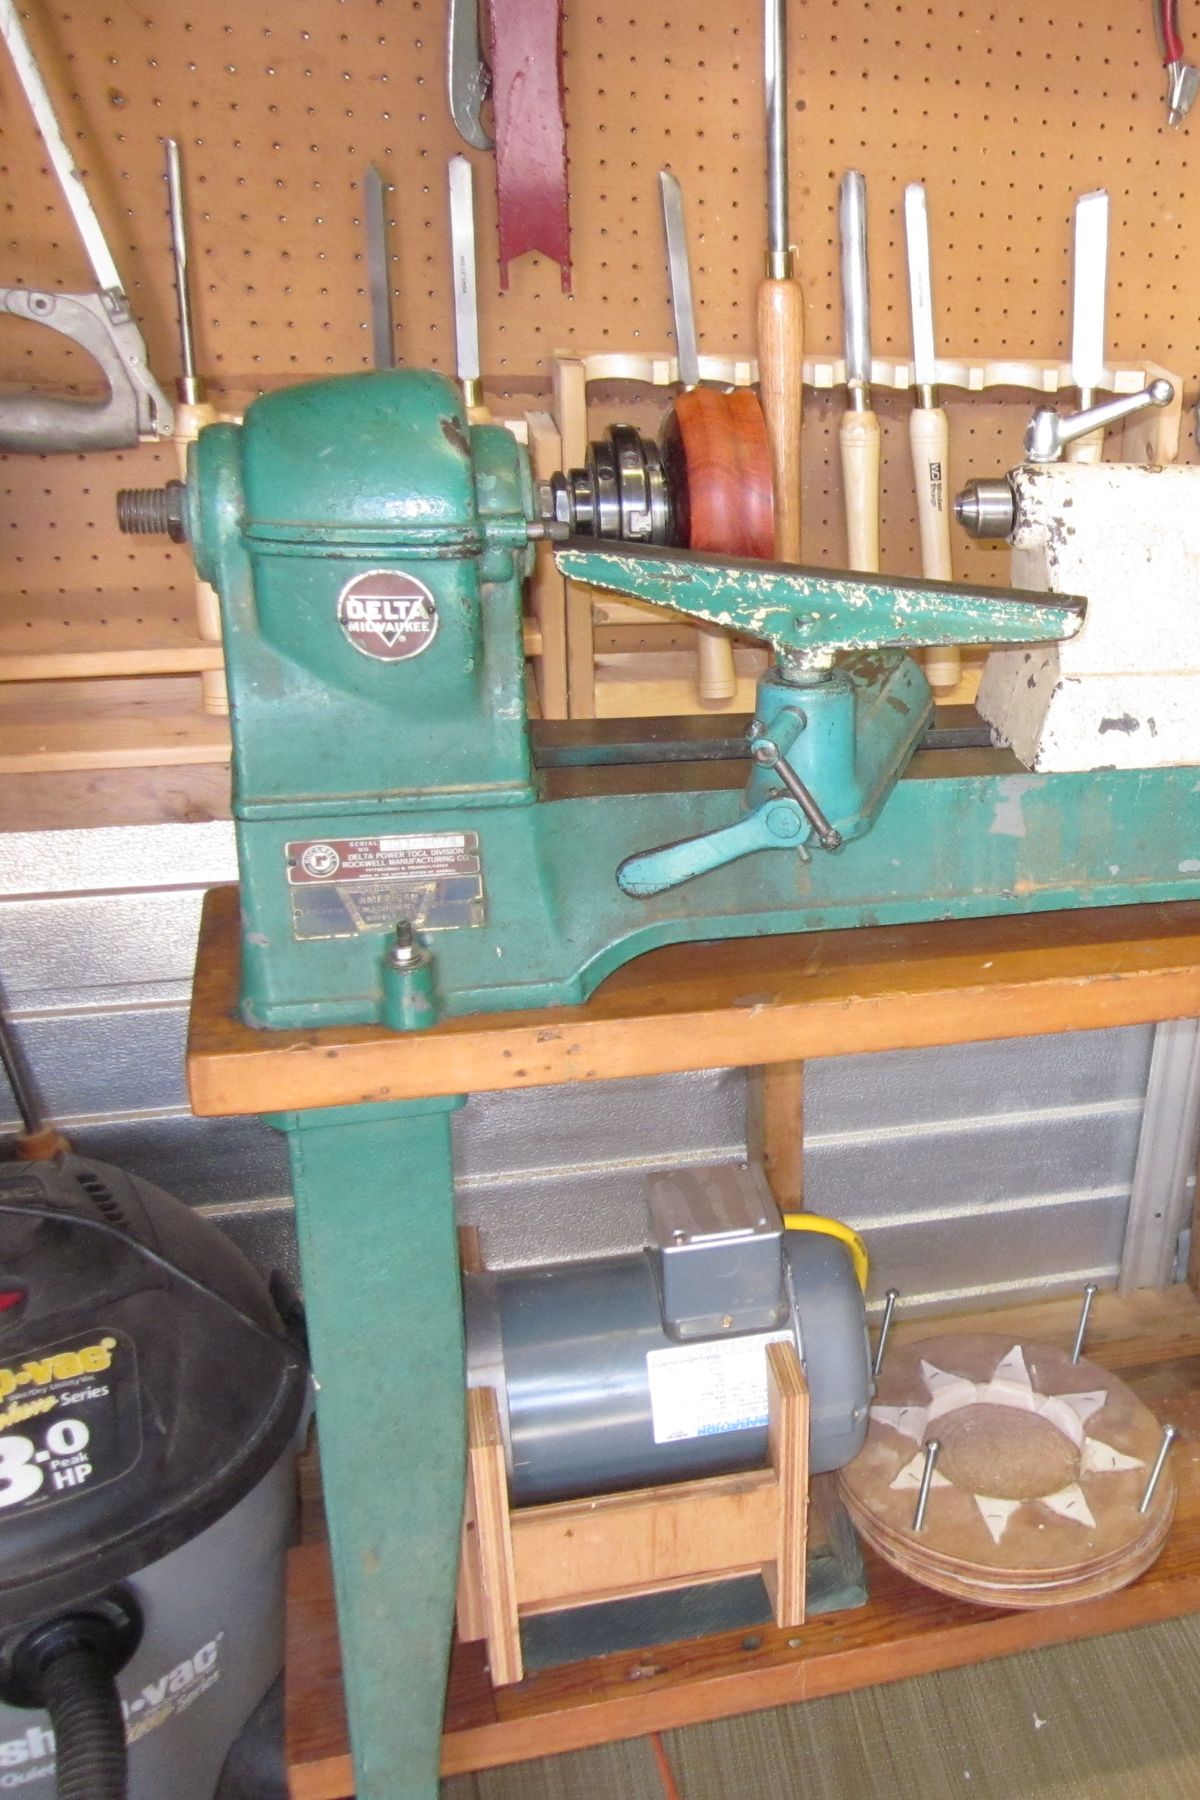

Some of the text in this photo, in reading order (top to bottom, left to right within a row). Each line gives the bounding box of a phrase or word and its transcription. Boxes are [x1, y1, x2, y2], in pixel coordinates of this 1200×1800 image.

[346, 600, 430, 620] DELTA
[347, 621, 431, 632] MILWAUKEE
[342, 859, 386, 869] ROCKWELL
[388, 855, 455, 866] MANUFACTURING
[348, 853, 374, 861] DELTA
[376, 850, 406, 859] POWER
[430, 847, 465, 856] DIVISION
[59, 1385, 110, 1406] Series
[51, 1451, 90, 1470] Peak
[52, 1463, 93, 1490] HP
